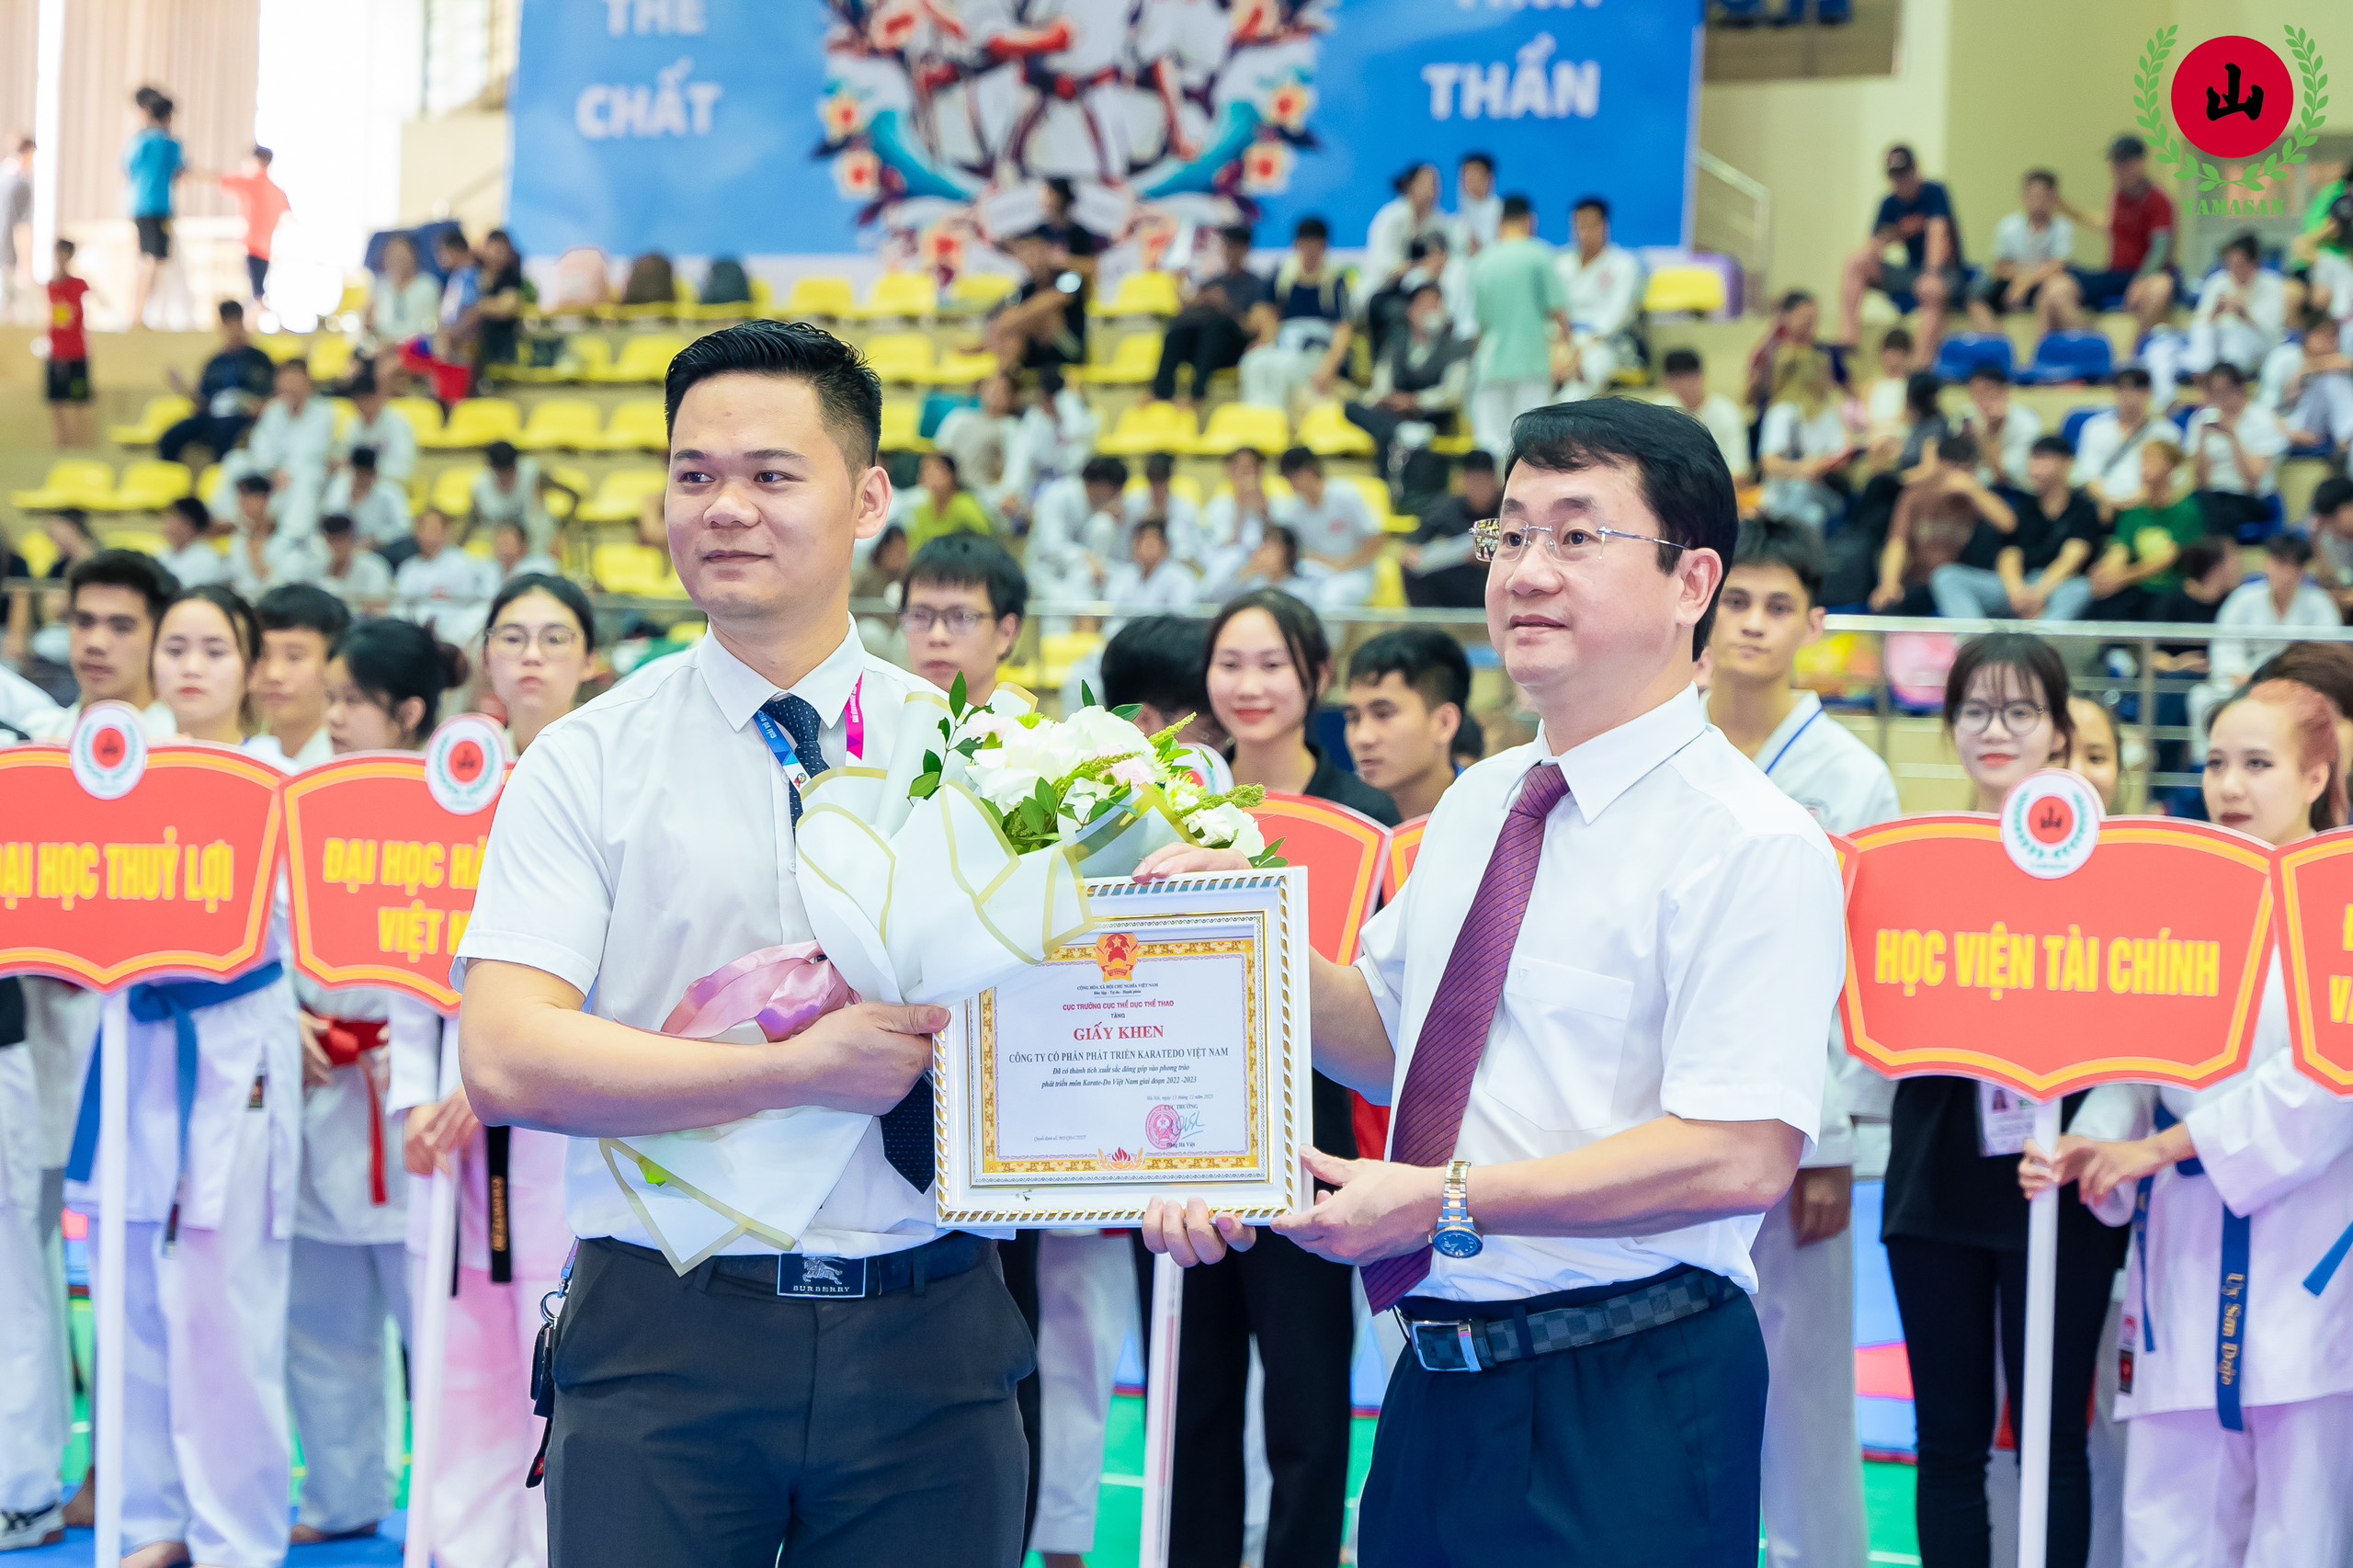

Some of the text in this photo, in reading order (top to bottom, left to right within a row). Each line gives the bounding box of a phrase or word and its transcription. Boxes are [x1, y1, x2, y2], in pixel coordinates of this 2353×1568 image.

[576, 57, 722, 138] CHẤT
[0, 842, 33, 910] ẠI
[38, 842, 99, 911] HỌC
[185, 839, 234, 914] LỢI
[323, 837, 378, 893] ĐẠI
[381, 840, 446, 896] HỌC
[378, 899, 445, 963] VIỆT
[1875, 921, 2221, 1000] HỌC VIỆN TÀI CHÍNH
[1102, 1002, 1116, 1010] CỤC
[1117, 999, 1129, 1008] THỂ
[1144, 998, 1156, 1007] THỂ
[1074, 1021, 1165, 1041] GIẤY KHEN
[1009, 1051, 1033, 1062] CÔNG
[1035, 1053, 1046, 1062] TY
[1086, 1049, 1108, 1061] PHÁT
[1138, 1049, 1185, 1059] KARATEDO
[1187, 1047, 1207, 1059] VIỆT
[1209, 1047, 1229, 1057] NAM
[1111, 1063, 1121, 1073] sắc
[1121, 1065, 1136, 1074] đóng
[1137, 1064, 1148, 1074] góp
[1158, 1064, 1177, 1073] phong
[1040, 1080, 1054, 1089] phát
[1083, 1078, 1112, 1086] Karate-Do
[1112, 1078, 1124, 1087] Việt
[1139, 1077, 1151, 1086] giai
[1151, 1077, 1165, 1086] đoạn
[793, 1284, 850, 1292] BURBERRY
